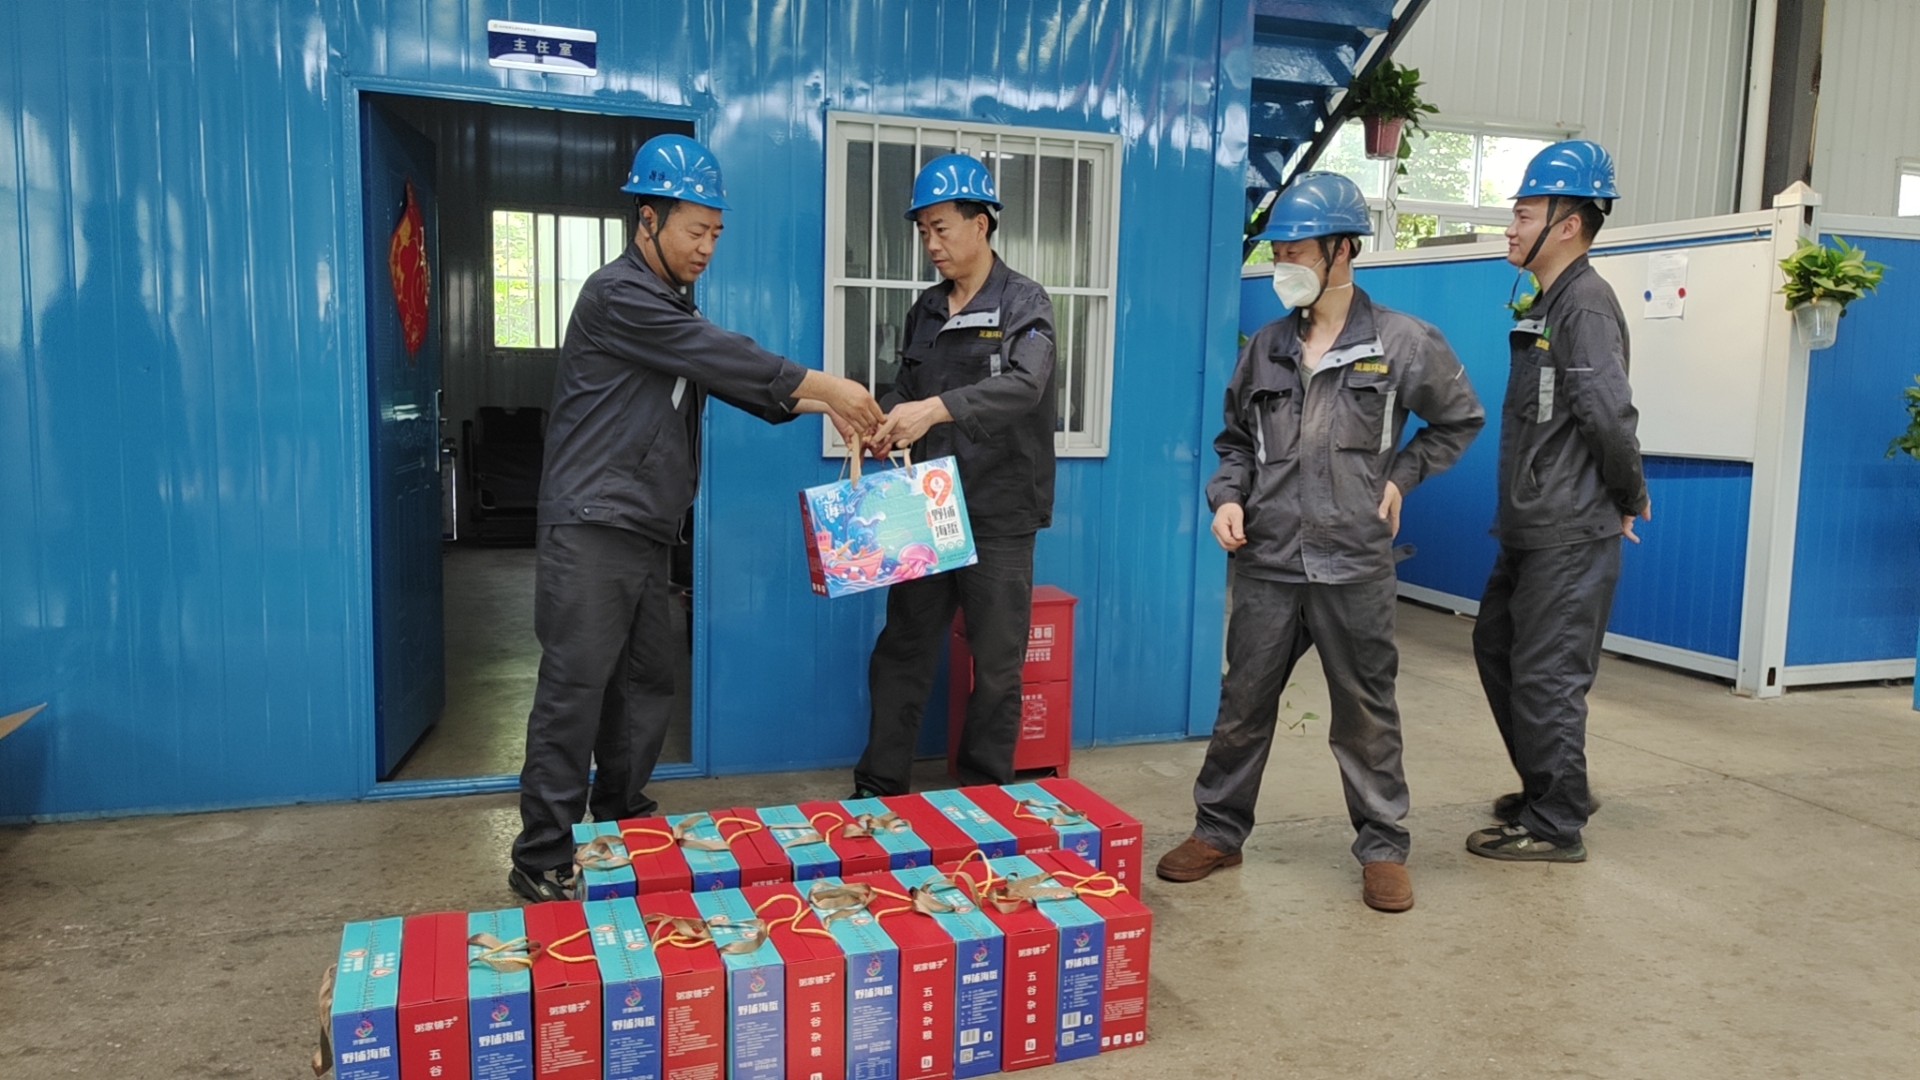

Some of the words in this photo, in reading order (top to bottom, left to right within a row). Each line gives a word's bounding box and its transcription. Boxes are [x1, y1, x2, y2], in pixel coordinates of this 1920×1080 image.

[513, 37, 573, 56] 主任室
[798, 974, 833, 987] 粥家铺子
[675, 987, 712, 1000] 粥家铺子
[548, 1002, 587, 1016] 粥家铺子
[922, 987, 933, 1040] 五谷杂粮
[413, 1018, 454, 1033] 粥家铺子
[810, 1002, 822, 1057] 五谷杂粮
[479, 1030, 525, 1047] 野捕海蜇
[341, 1046, 391, 1064] 野捕海蜇
[429, 1049, 442, 1077] 五谷
